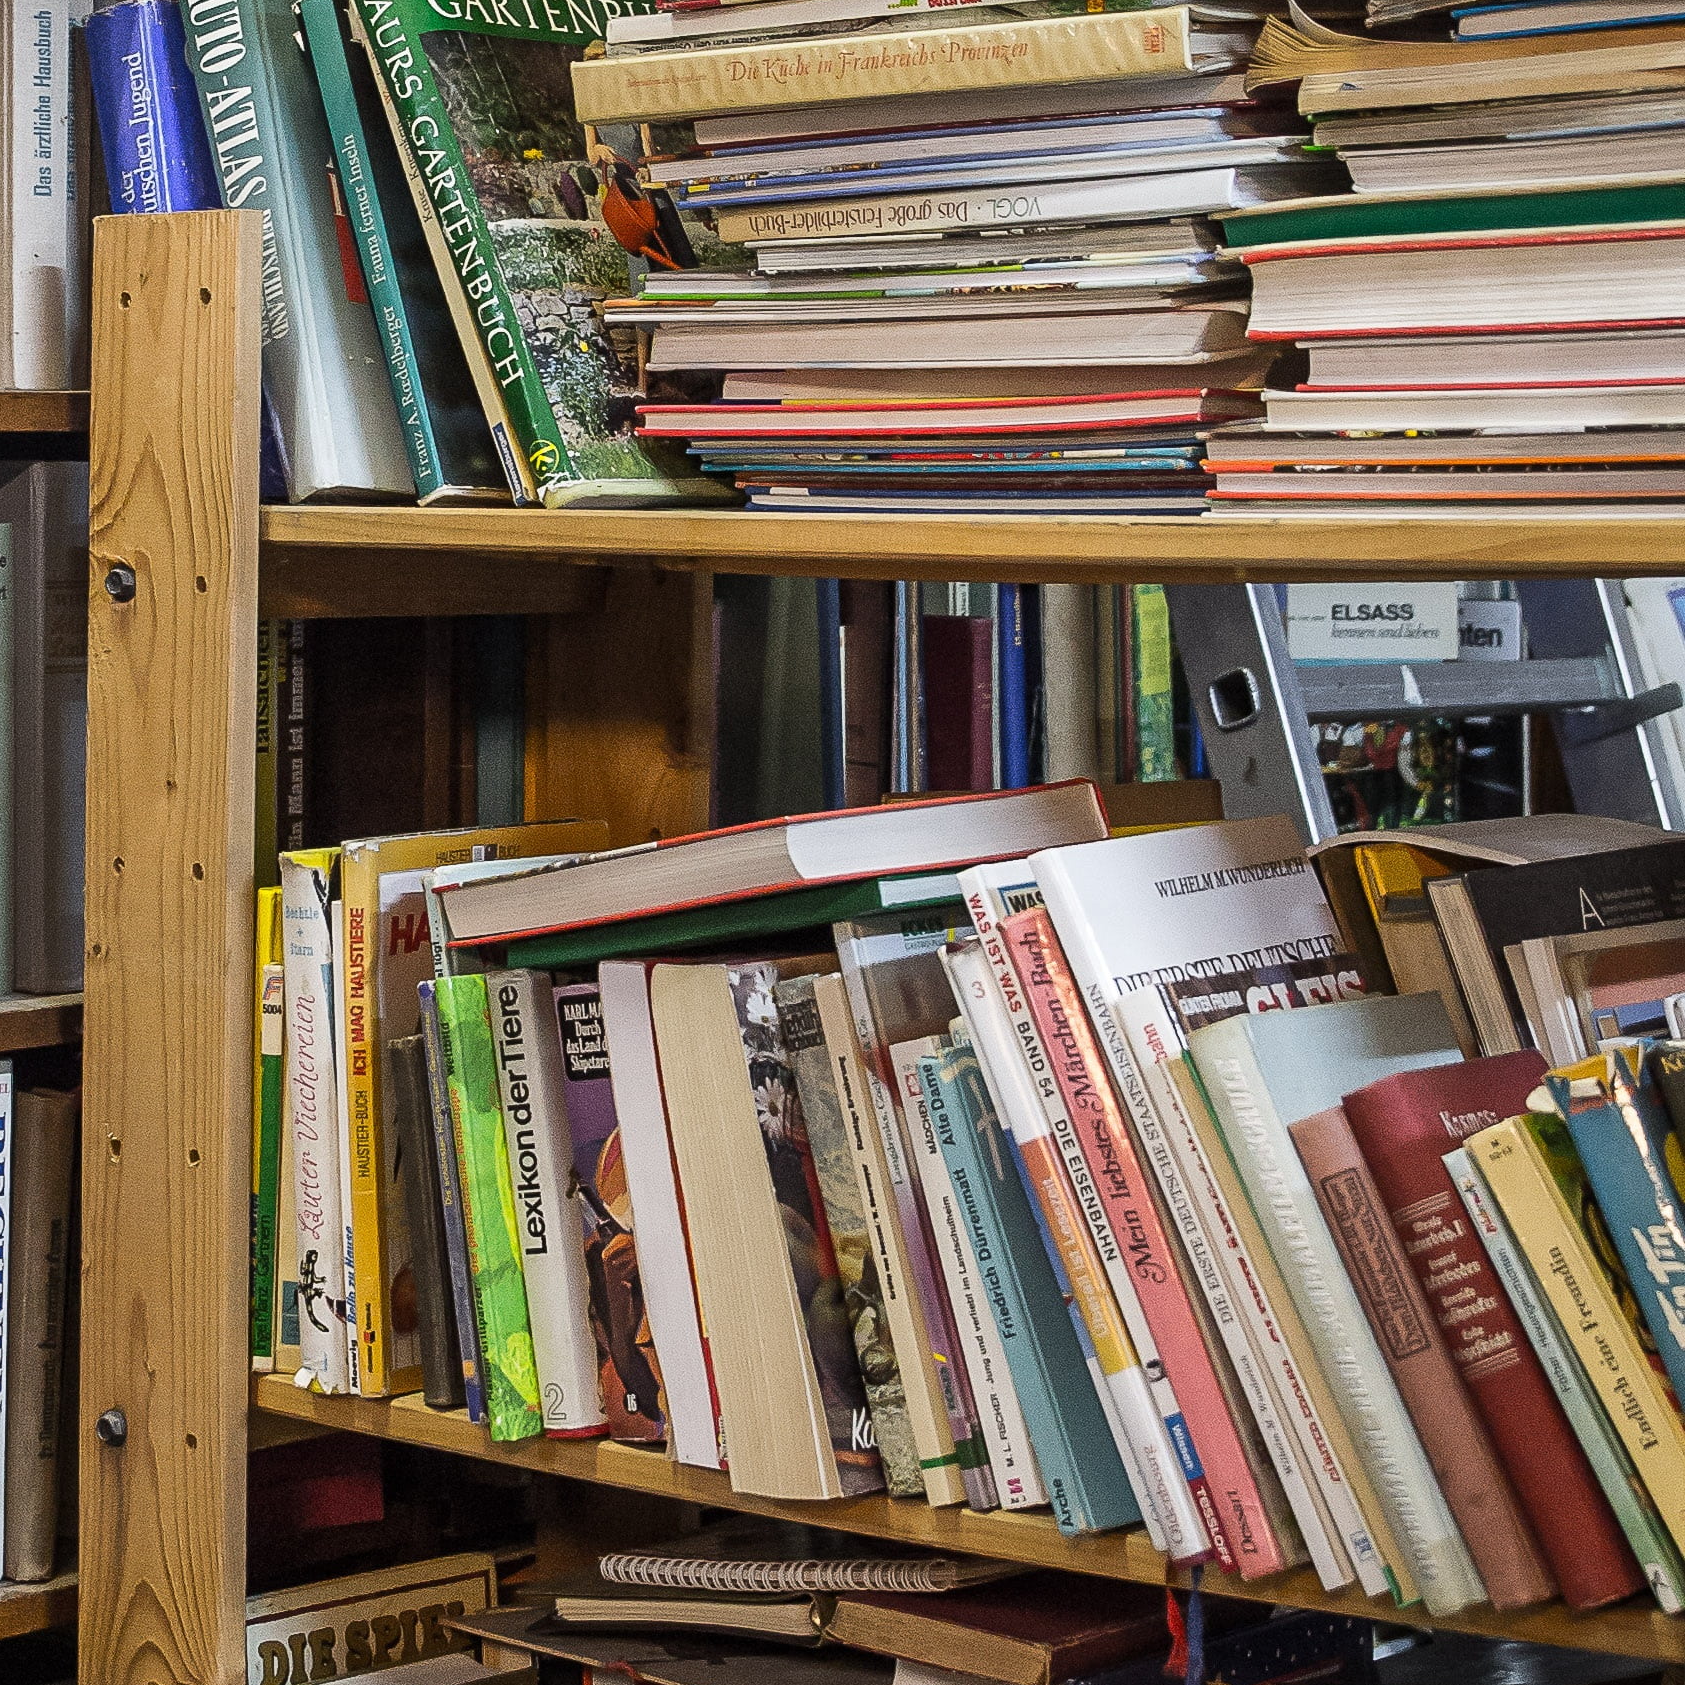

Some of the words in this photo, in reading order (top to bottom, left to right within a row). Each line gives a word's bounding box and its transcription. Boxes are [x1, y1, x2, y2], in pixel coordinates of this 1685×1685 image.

[33, 9, 53, 89] Hausbuch
[33, 96, 53, 160] ärztliche
[34, 165, 53, 198] Das
[988, 195, 1042, 221] VOGL
[410, 115, 527, 388] GARTENBUCH
[348, 907, 367, 1000] HAUSTIERE
[350, 1003, 367, 1044] MAG
[497, 983, 528, 1066] Tiere
[352, 1047, 368, 1077] ICH
[506, 1066, 535, 1129] der
[969, 891, 993, 930] WAS
[984, 931, 1005, 968] IST
[997, 971, 1023, 1014] WAS
[1016, 1018, 1046, 1069] BAND
[1035, 1068, 1055, 1102] 54
[1053, 1116, 1072, 1150] DIE
[1063, 1149, 1119, 1263] EISENBAHN
[356, 1089, 371, 1180] HAUSTIER-BUCH
[509, 1131, 549, 1257] Lexikon
[545, 1383, 568, 1421] 2
